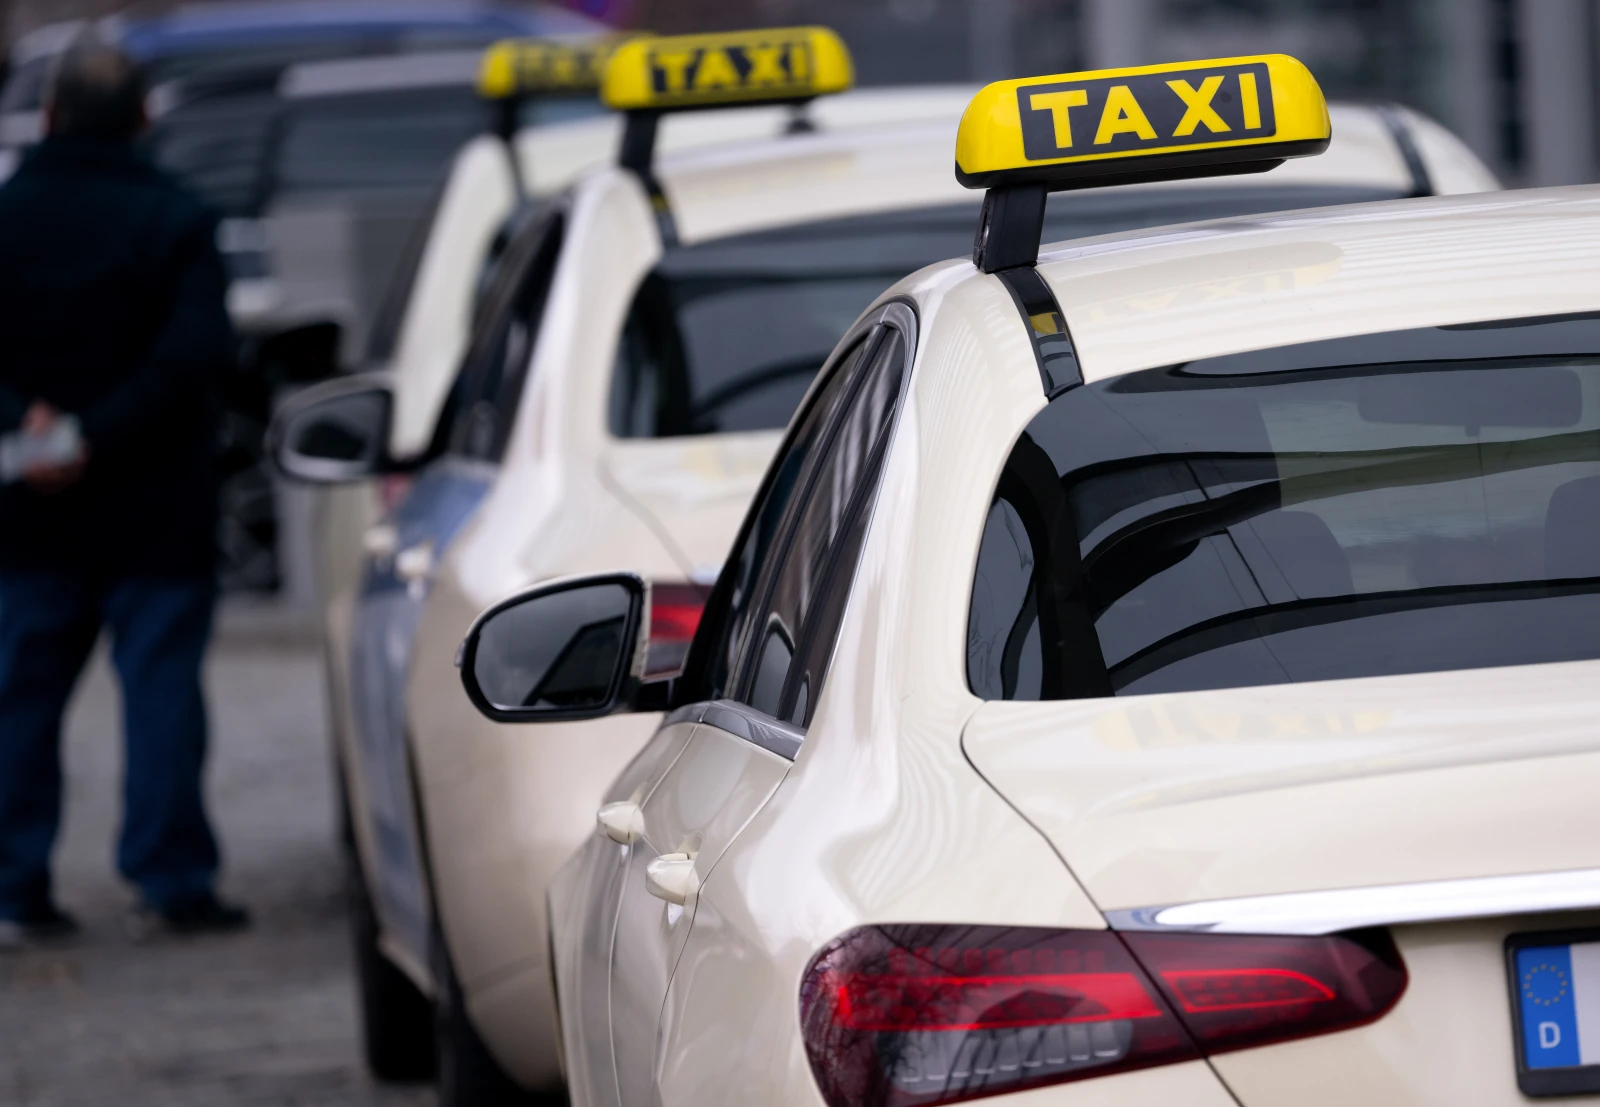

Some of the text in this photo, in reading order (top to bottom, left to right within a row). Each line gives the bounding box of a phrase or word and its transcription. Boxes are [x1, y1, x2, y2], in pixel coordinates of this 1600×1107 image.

[653, 44, 808, 94] TAXI
[1029, 72, 1262, 149] TAXI
[1538, 1020, 1561, 1049] D
